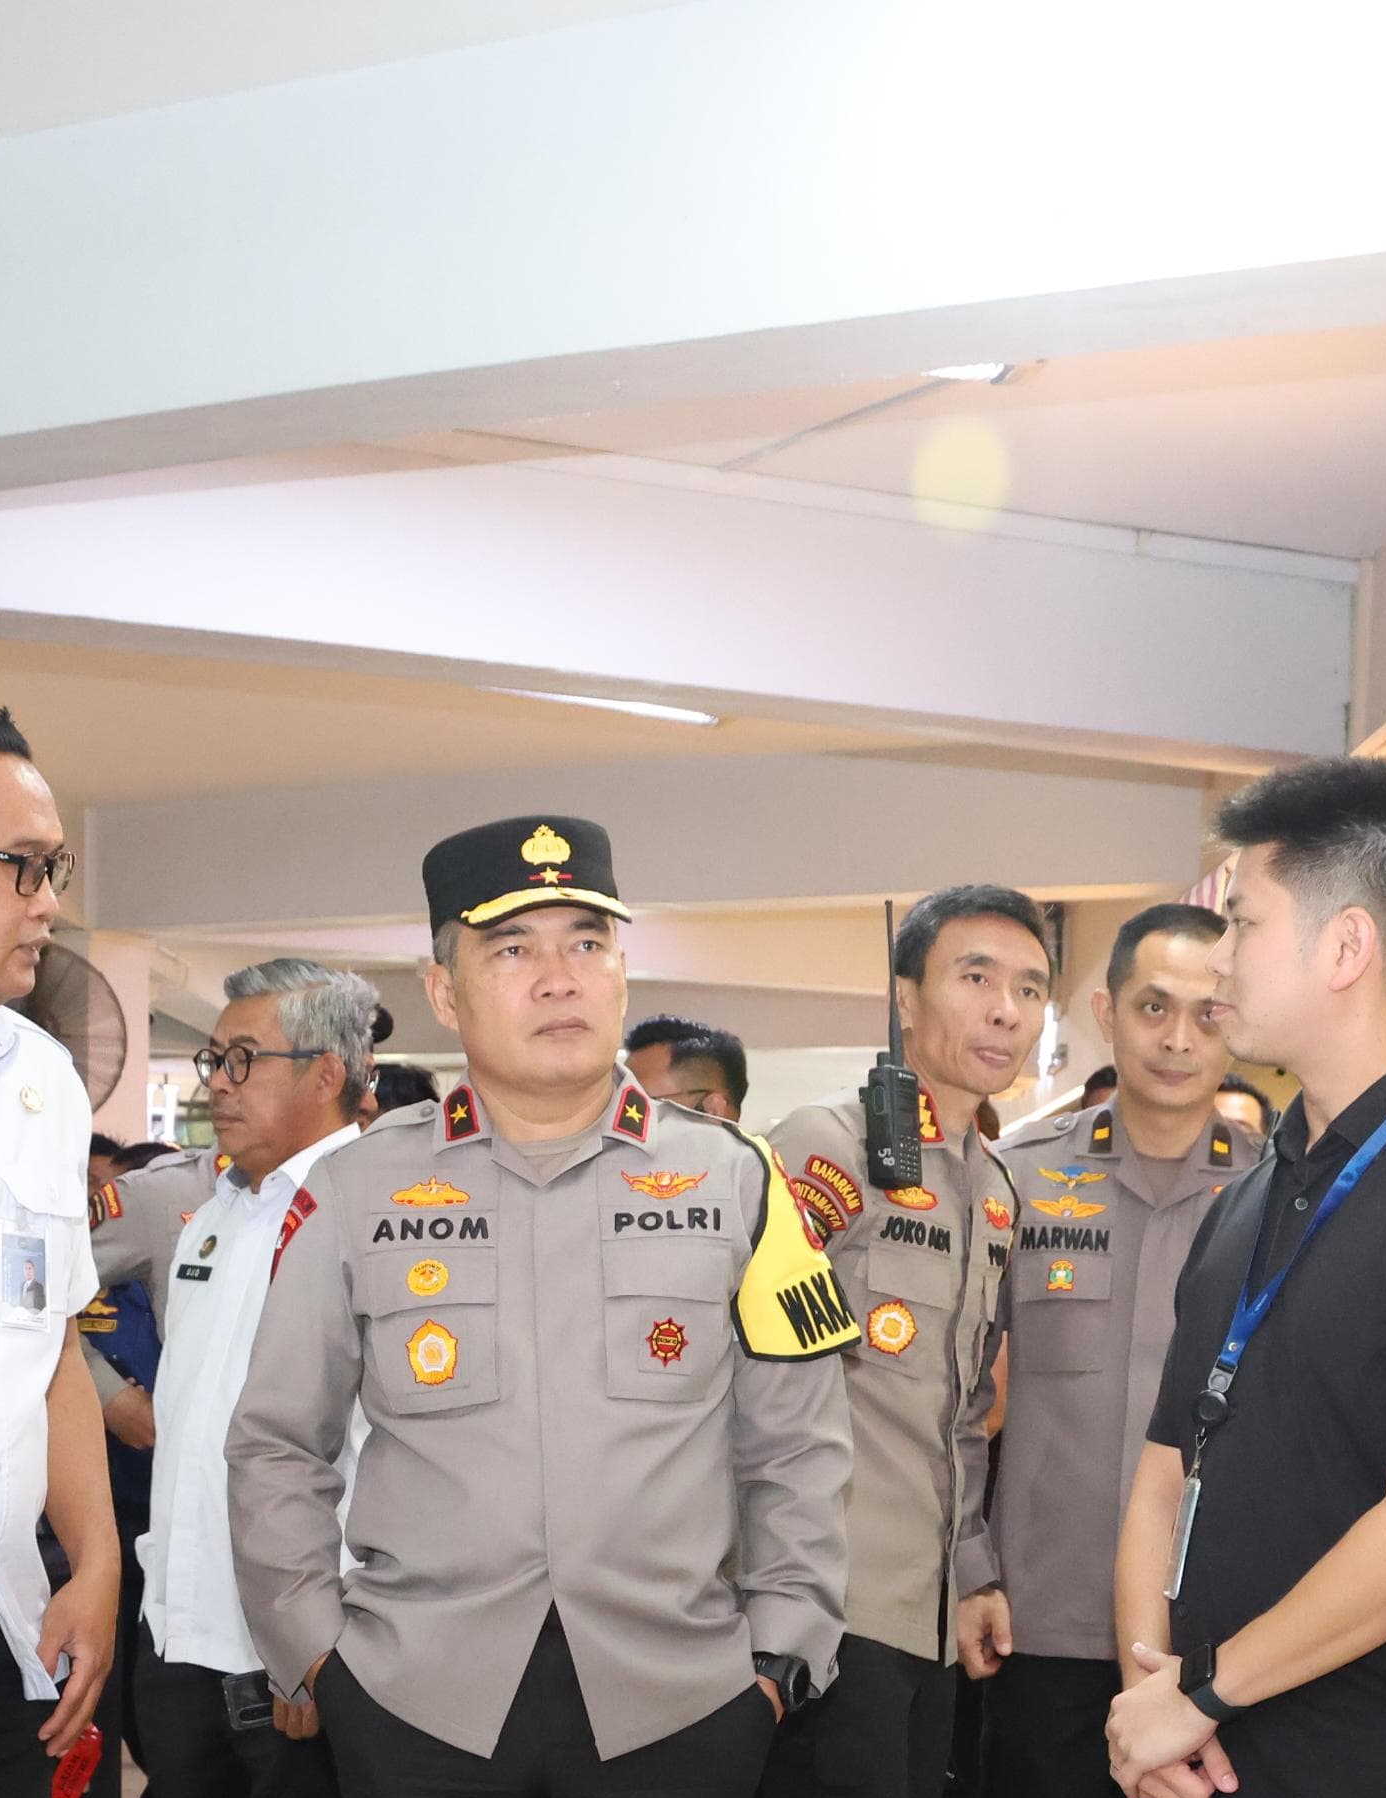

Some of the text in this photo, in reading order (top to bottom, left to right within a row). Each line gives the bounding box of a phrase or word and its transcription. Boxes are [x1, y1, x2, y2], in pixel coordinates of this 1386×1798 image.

[372, 1217, 489, 1243] ANOM
[614, 1207, 721, 1233] POLRI
[880, 1215, 926, 1246] JOKO
[1020, 1226, 1110, 1252] MARWAN
